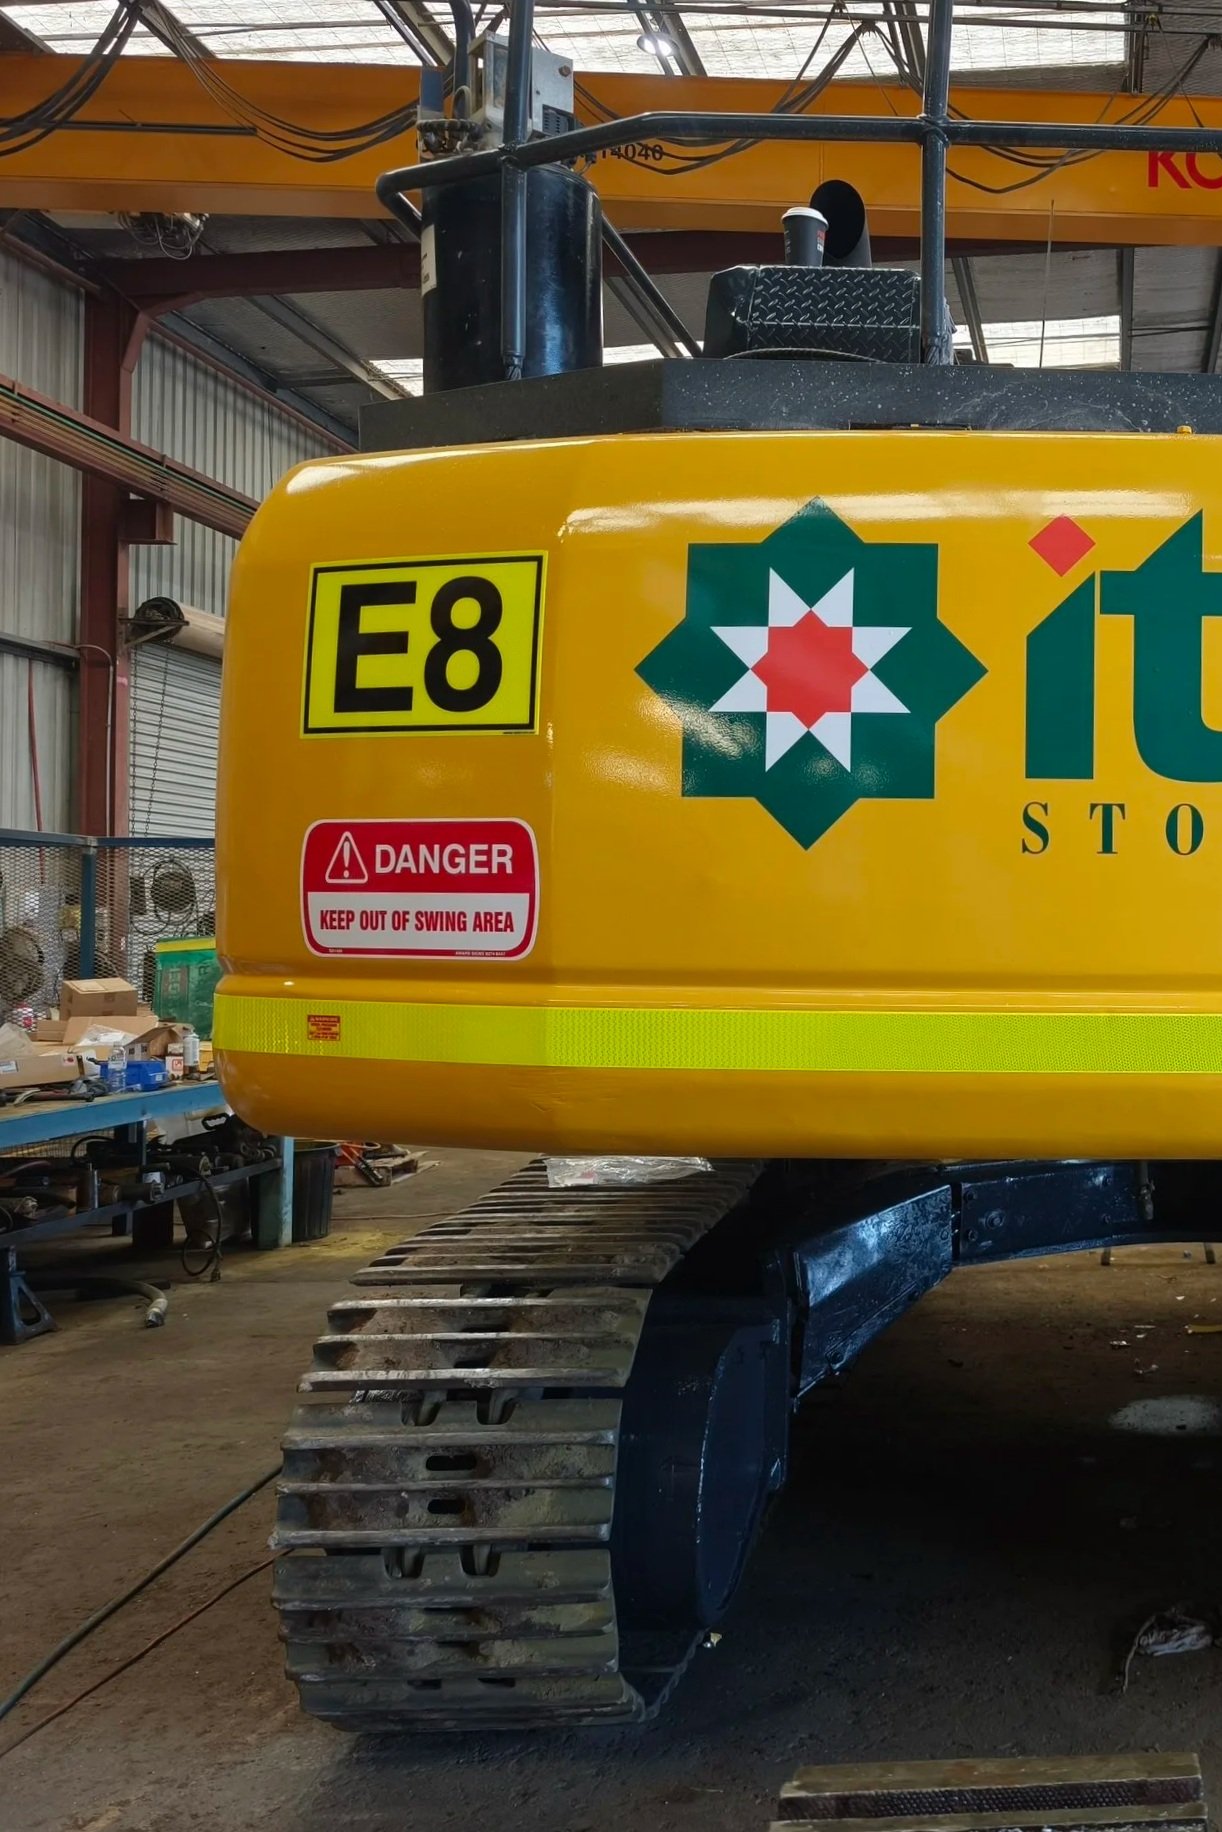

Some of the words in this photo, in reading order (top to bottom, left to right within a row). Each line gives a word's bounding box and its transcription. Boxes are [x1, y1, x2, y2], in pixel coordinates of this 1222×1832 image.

[334, 576, 503, 713] E8
[375, 843, 513, 874] DANGER
[320, 909, 355, 931] KEEP
[359, 910, 387, 931] OUT
[391, 910, 410, 931] OF
[414, 911, 467, 932] SWING
[472, 912, 514, 932] AREA
